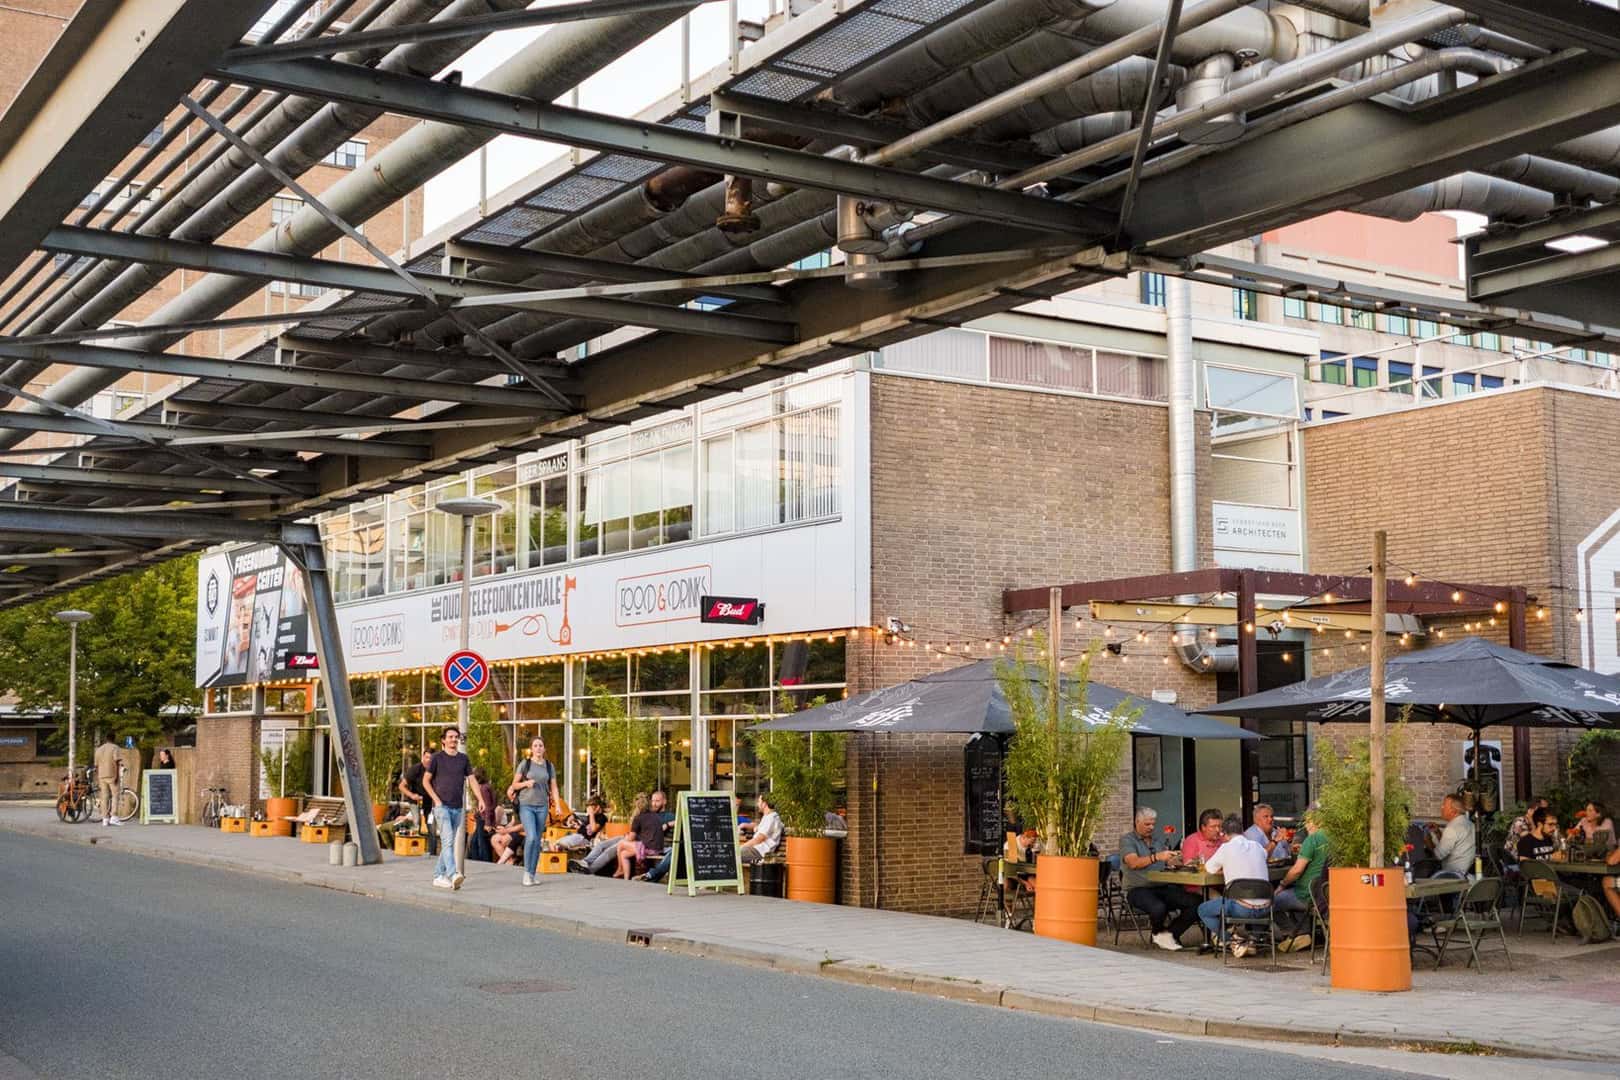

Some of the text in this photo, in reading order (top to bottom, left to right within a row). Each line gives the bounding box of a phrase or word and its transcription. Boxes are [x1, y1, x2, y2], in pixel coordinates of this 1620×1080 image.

[538, 455, 568, 475] SPAANS
[1232, 527, 1287, 540] ARCHITECTEN
[620, 575, 708, 617] FOOD & DRINKS
[717, 602, 745, 617] Bud
[294, 655, 316, 666] Bud
